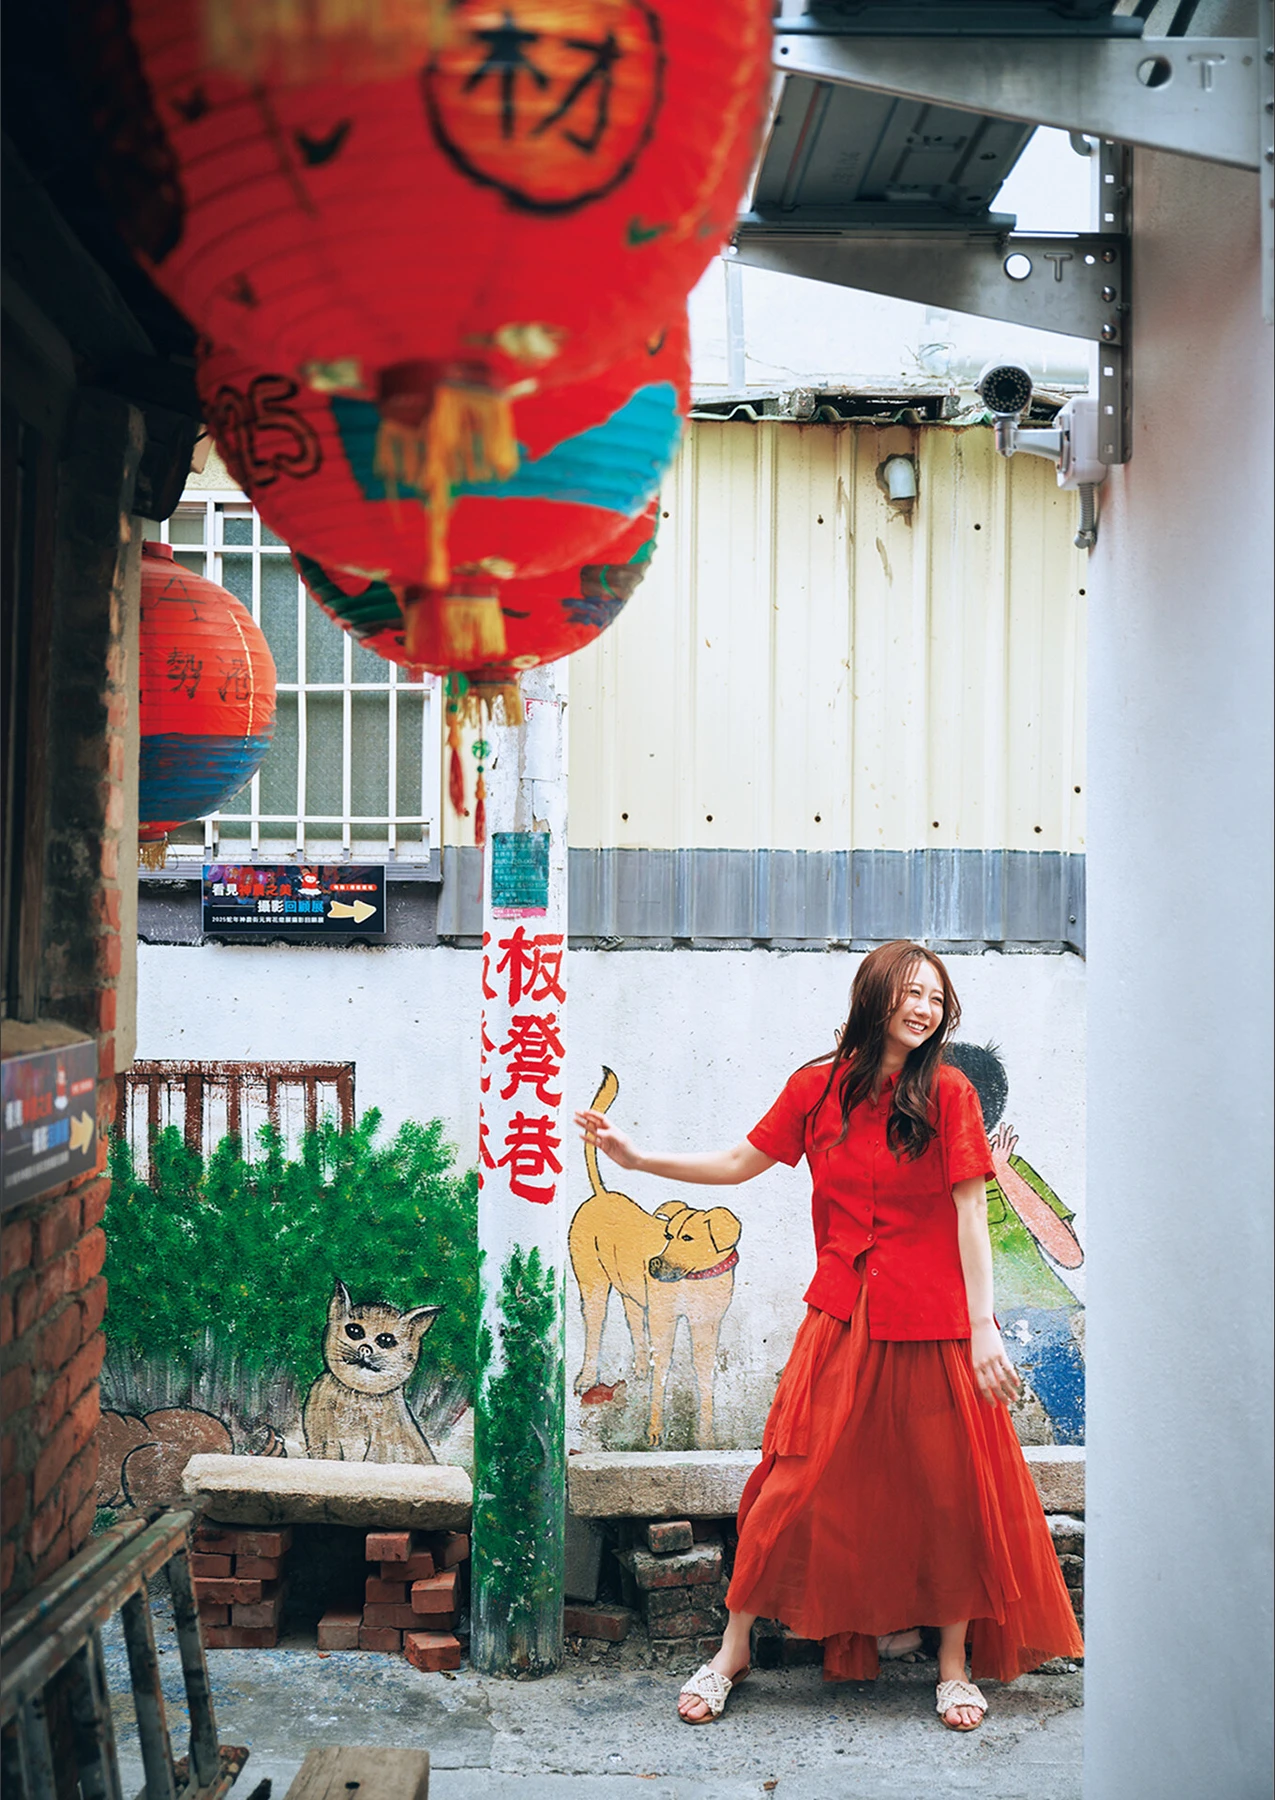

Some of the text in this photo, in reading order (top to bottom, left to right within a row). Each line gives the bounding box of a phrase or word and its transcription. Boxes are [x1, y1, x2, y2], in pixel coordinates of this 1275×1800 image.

[139, 646, 254, 702] 勢港
[212, 883, 292, 896] 看見神農之美
[257, 900, 325, 913] 攝影回顧展
[496, 925, 567, 1205] 板凳巷
